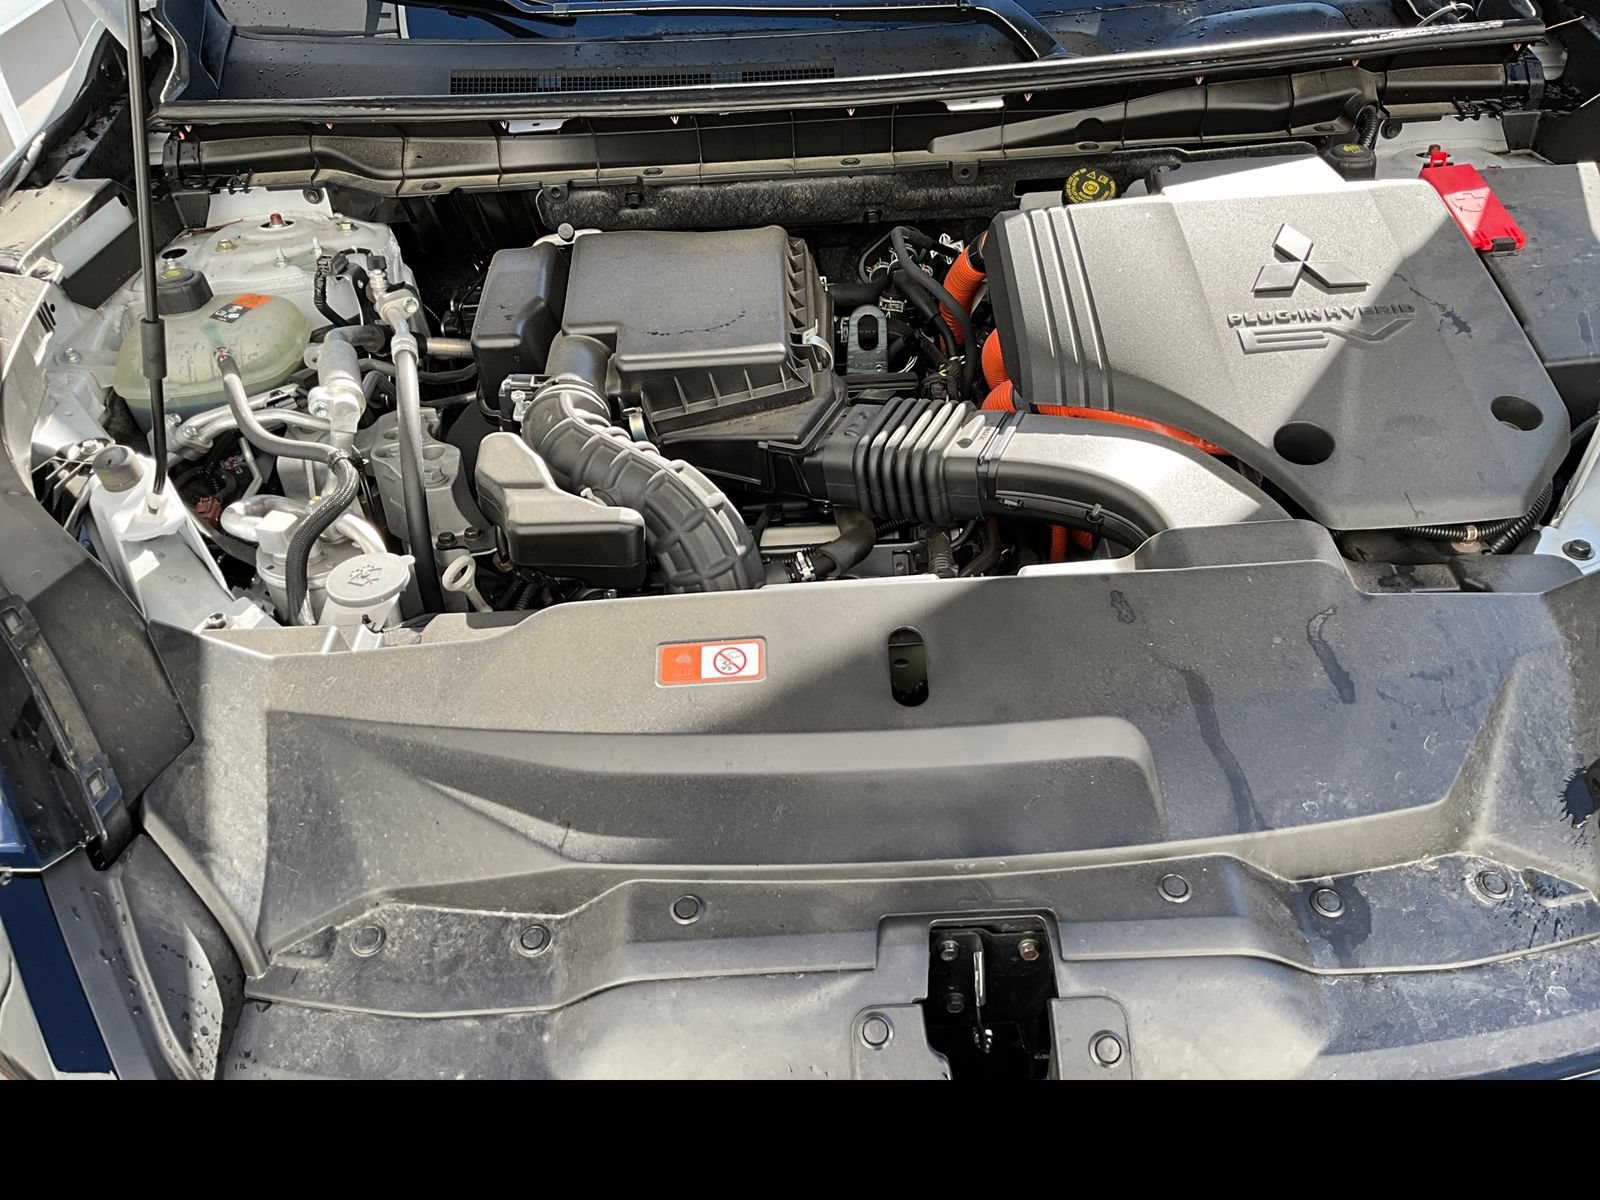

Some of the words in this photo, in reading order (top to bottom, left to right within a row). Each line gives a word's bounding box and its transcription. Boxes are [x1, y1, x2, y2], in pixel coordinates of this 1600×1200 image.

[1227, 309, 1322, 328] PLUG-IN
[1324, 303, 1416, 322] HYBRID
[1237, 318, 1415, 355] EV
